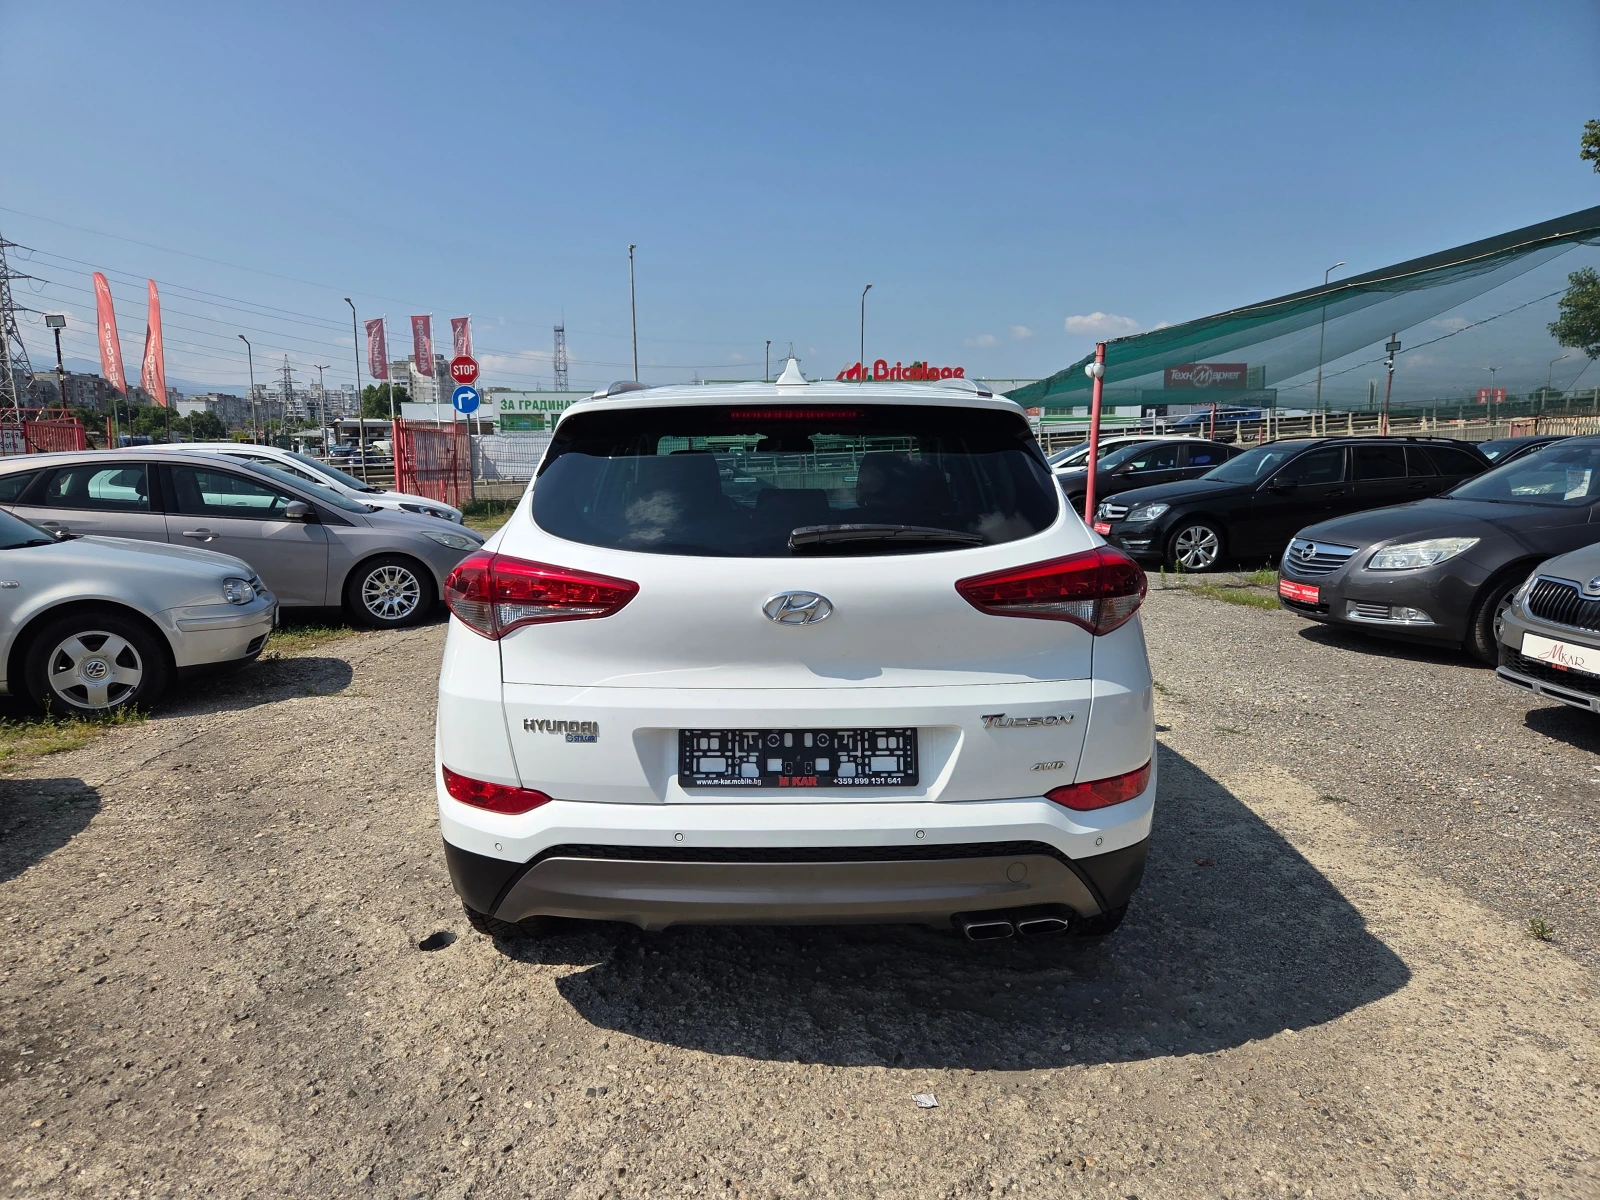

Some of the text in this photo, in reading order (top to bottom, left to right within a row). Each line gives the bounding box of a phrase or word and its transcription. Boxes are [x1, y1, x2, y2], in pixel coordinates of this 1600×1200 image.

[453, 365, 476, 376] STOP
[500, 399, 515, 410] ЗА
[523, 718, 598, 734] HYUNDAI
[980, 713, 1074, 729] TUCSON
[779, 776, 818, 787] M KAR
[833, 777, 852, 785] +359
[854, 777, 869, 785] 899
[871, 777, 885, 785] 131
